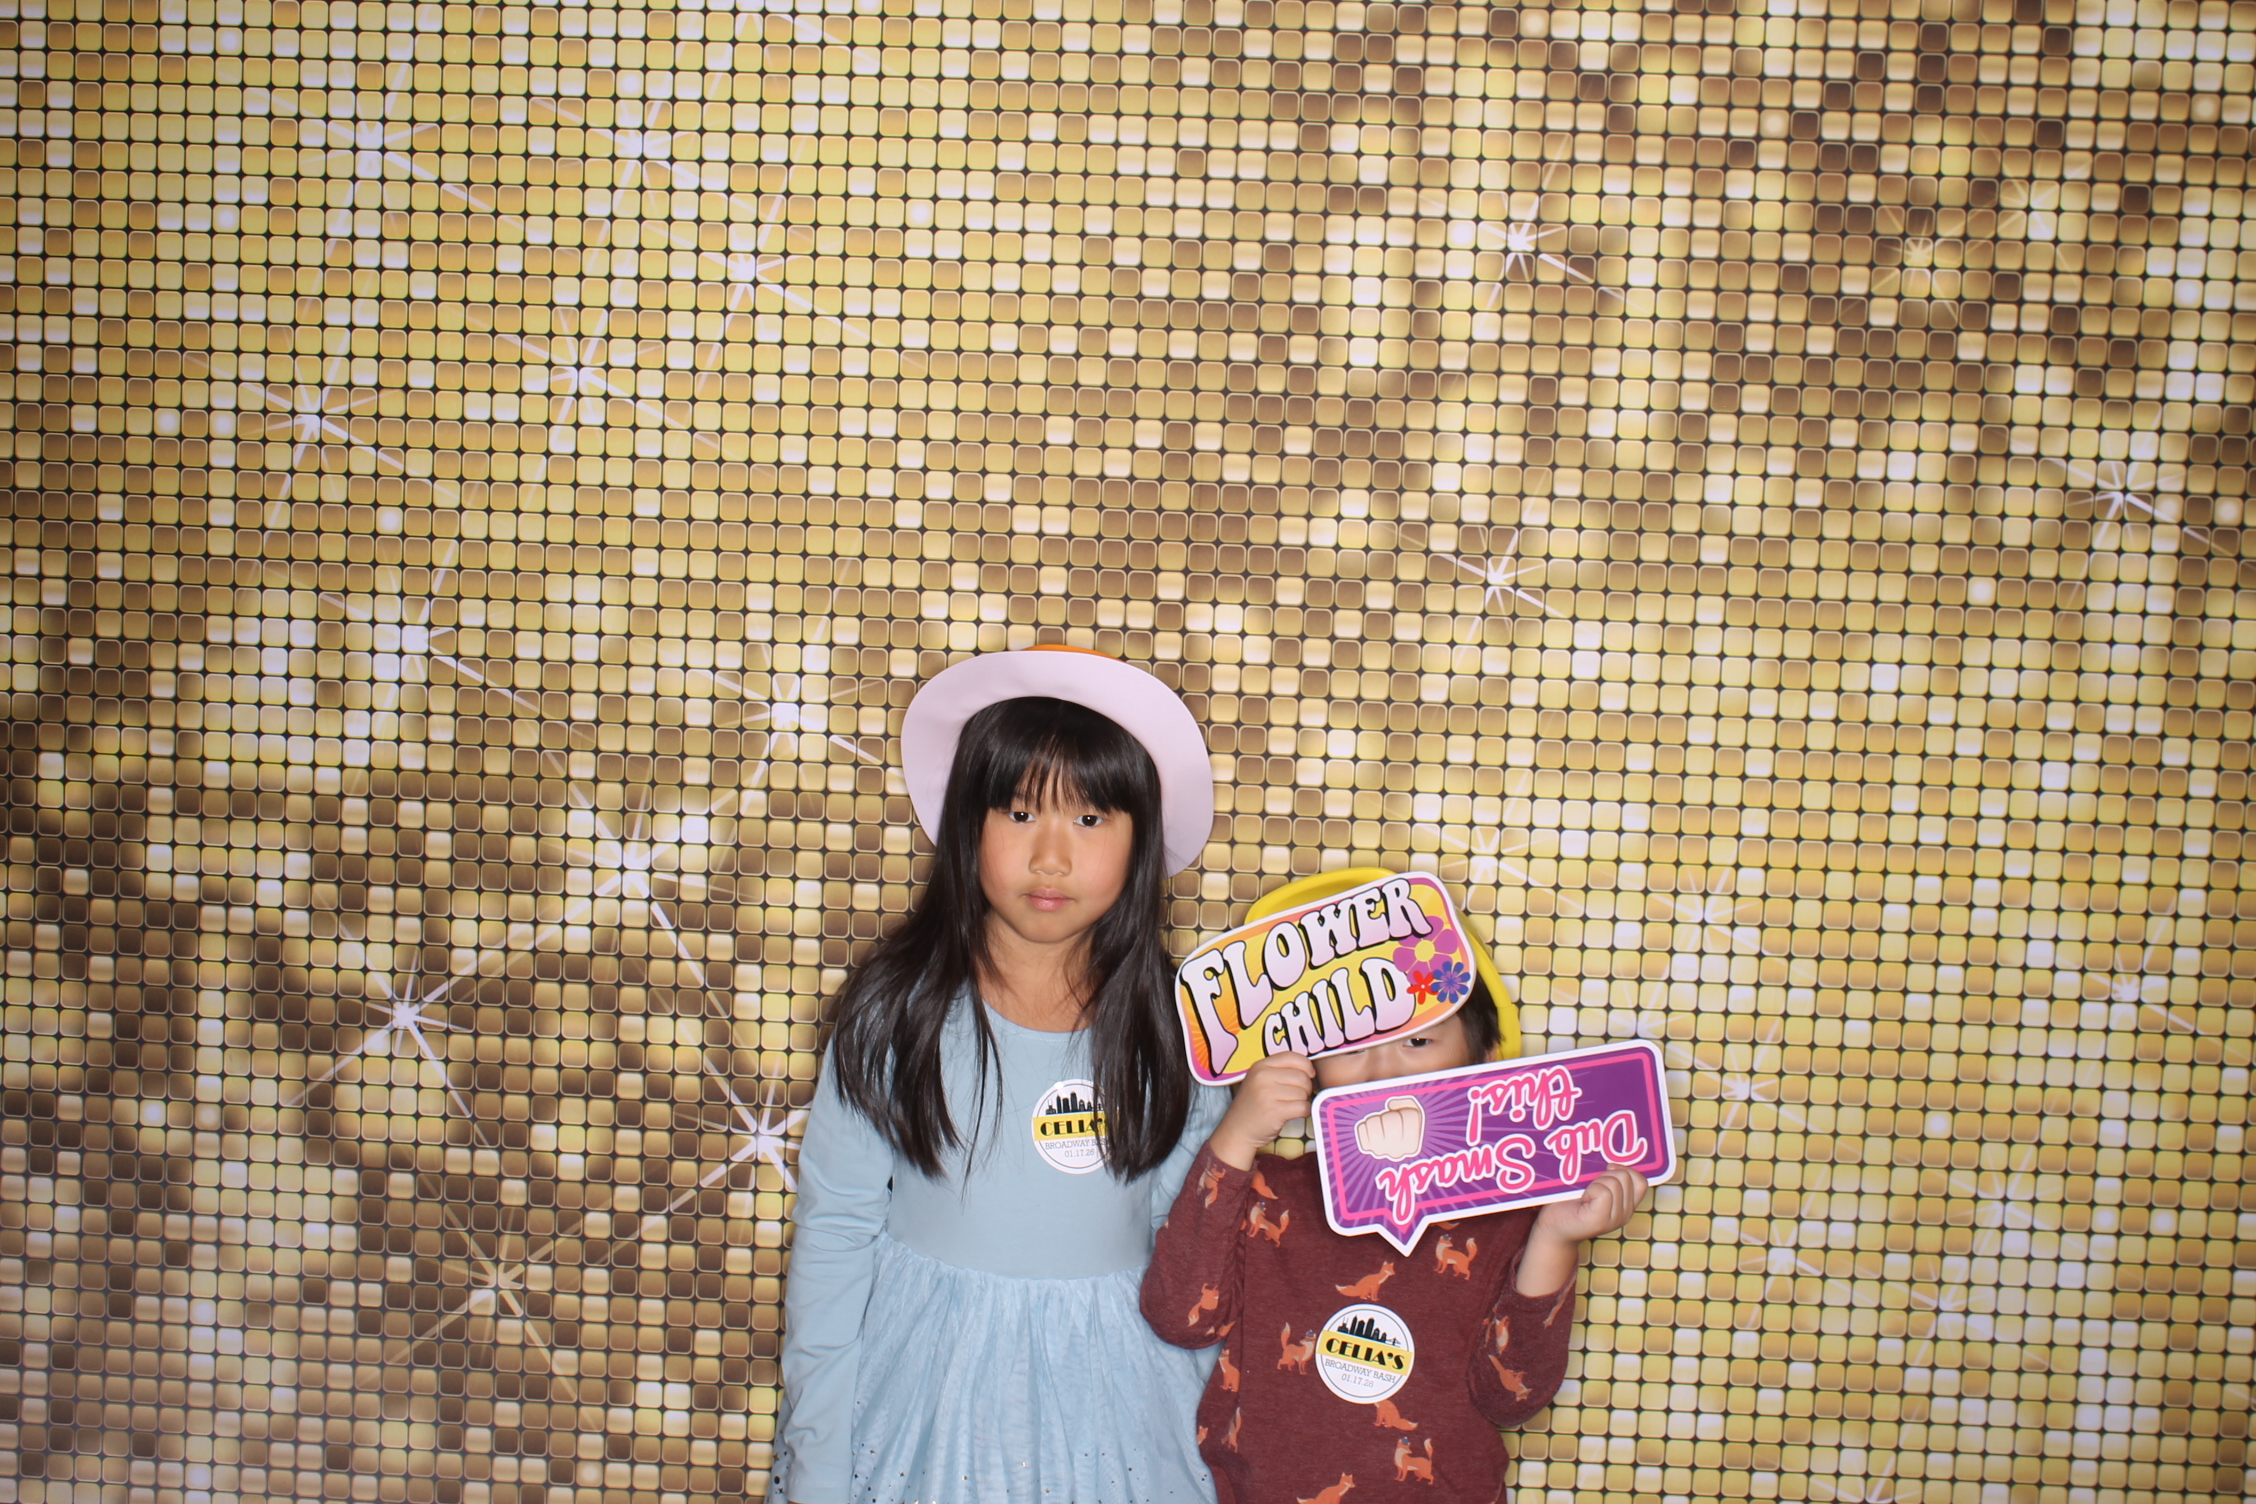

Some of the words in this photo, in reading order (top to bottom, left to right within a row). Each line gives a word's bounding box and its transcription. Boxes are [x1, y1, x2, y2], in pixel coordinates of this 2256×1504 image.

[1180, 878, 1433, 1077] FLOWER
[1262, 957, 1416, 1058] CHILD
[1040, 1117, 1105, 1137] CELIA'
[1465, 1064, 1582, 1147] this!
[1045, 1139, 1090, 1150] BROADWAY
[1375, 1133, 1536, 1225] Smash
[1545, 1110, 1648, 1184] Dub
[1324, 1359, 1372, 1377] BROADWAY
[1373, 1370, 1396, 1384] BASH
[1325, 1338, 1405, 1370] CELIA'S
